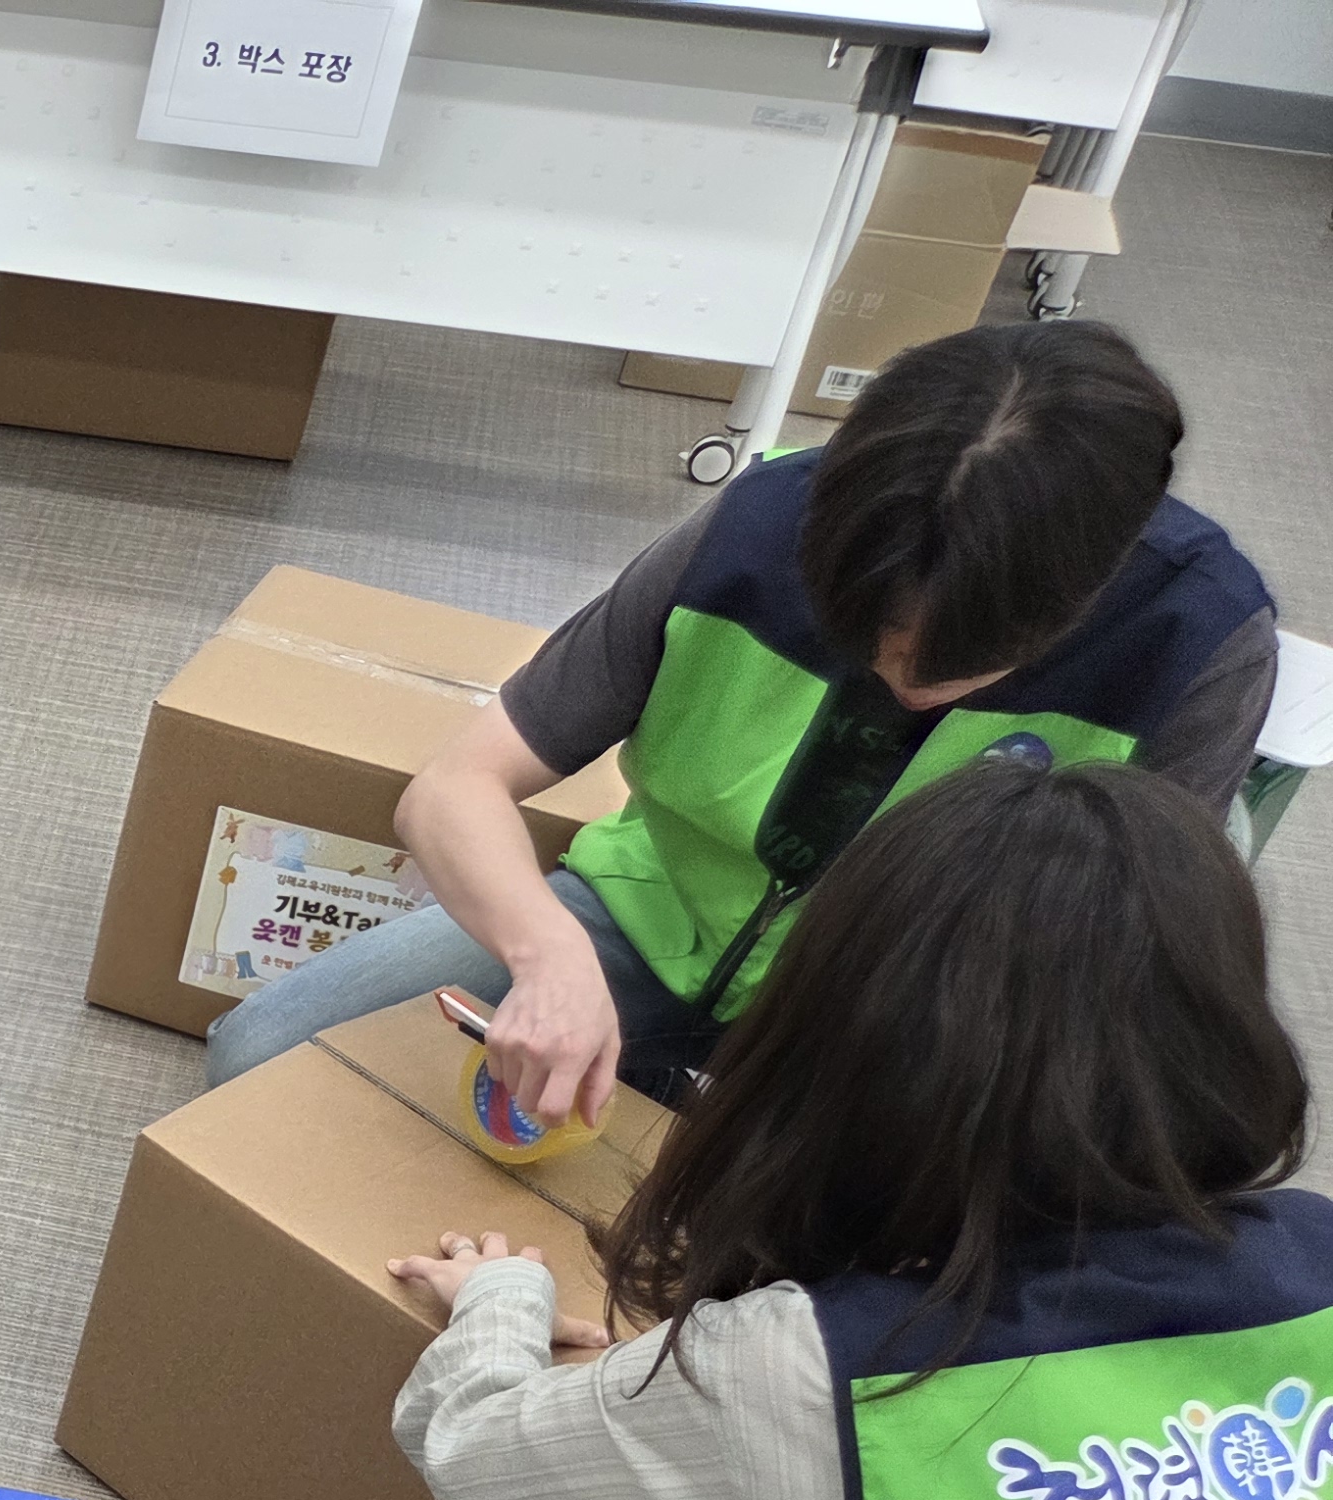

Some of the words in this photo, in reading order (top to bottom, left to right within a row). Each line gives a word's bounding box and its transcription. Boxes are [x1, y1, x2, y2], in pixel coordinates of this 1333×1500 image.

[202, 41, 222, 67] 3.
[237, 44, 285, 74] 박스
[298, 51, 352, 84] 포장
[274, 895, 381, 932] 기부&Ta
[252, 918, 302, 949] 옷캔
